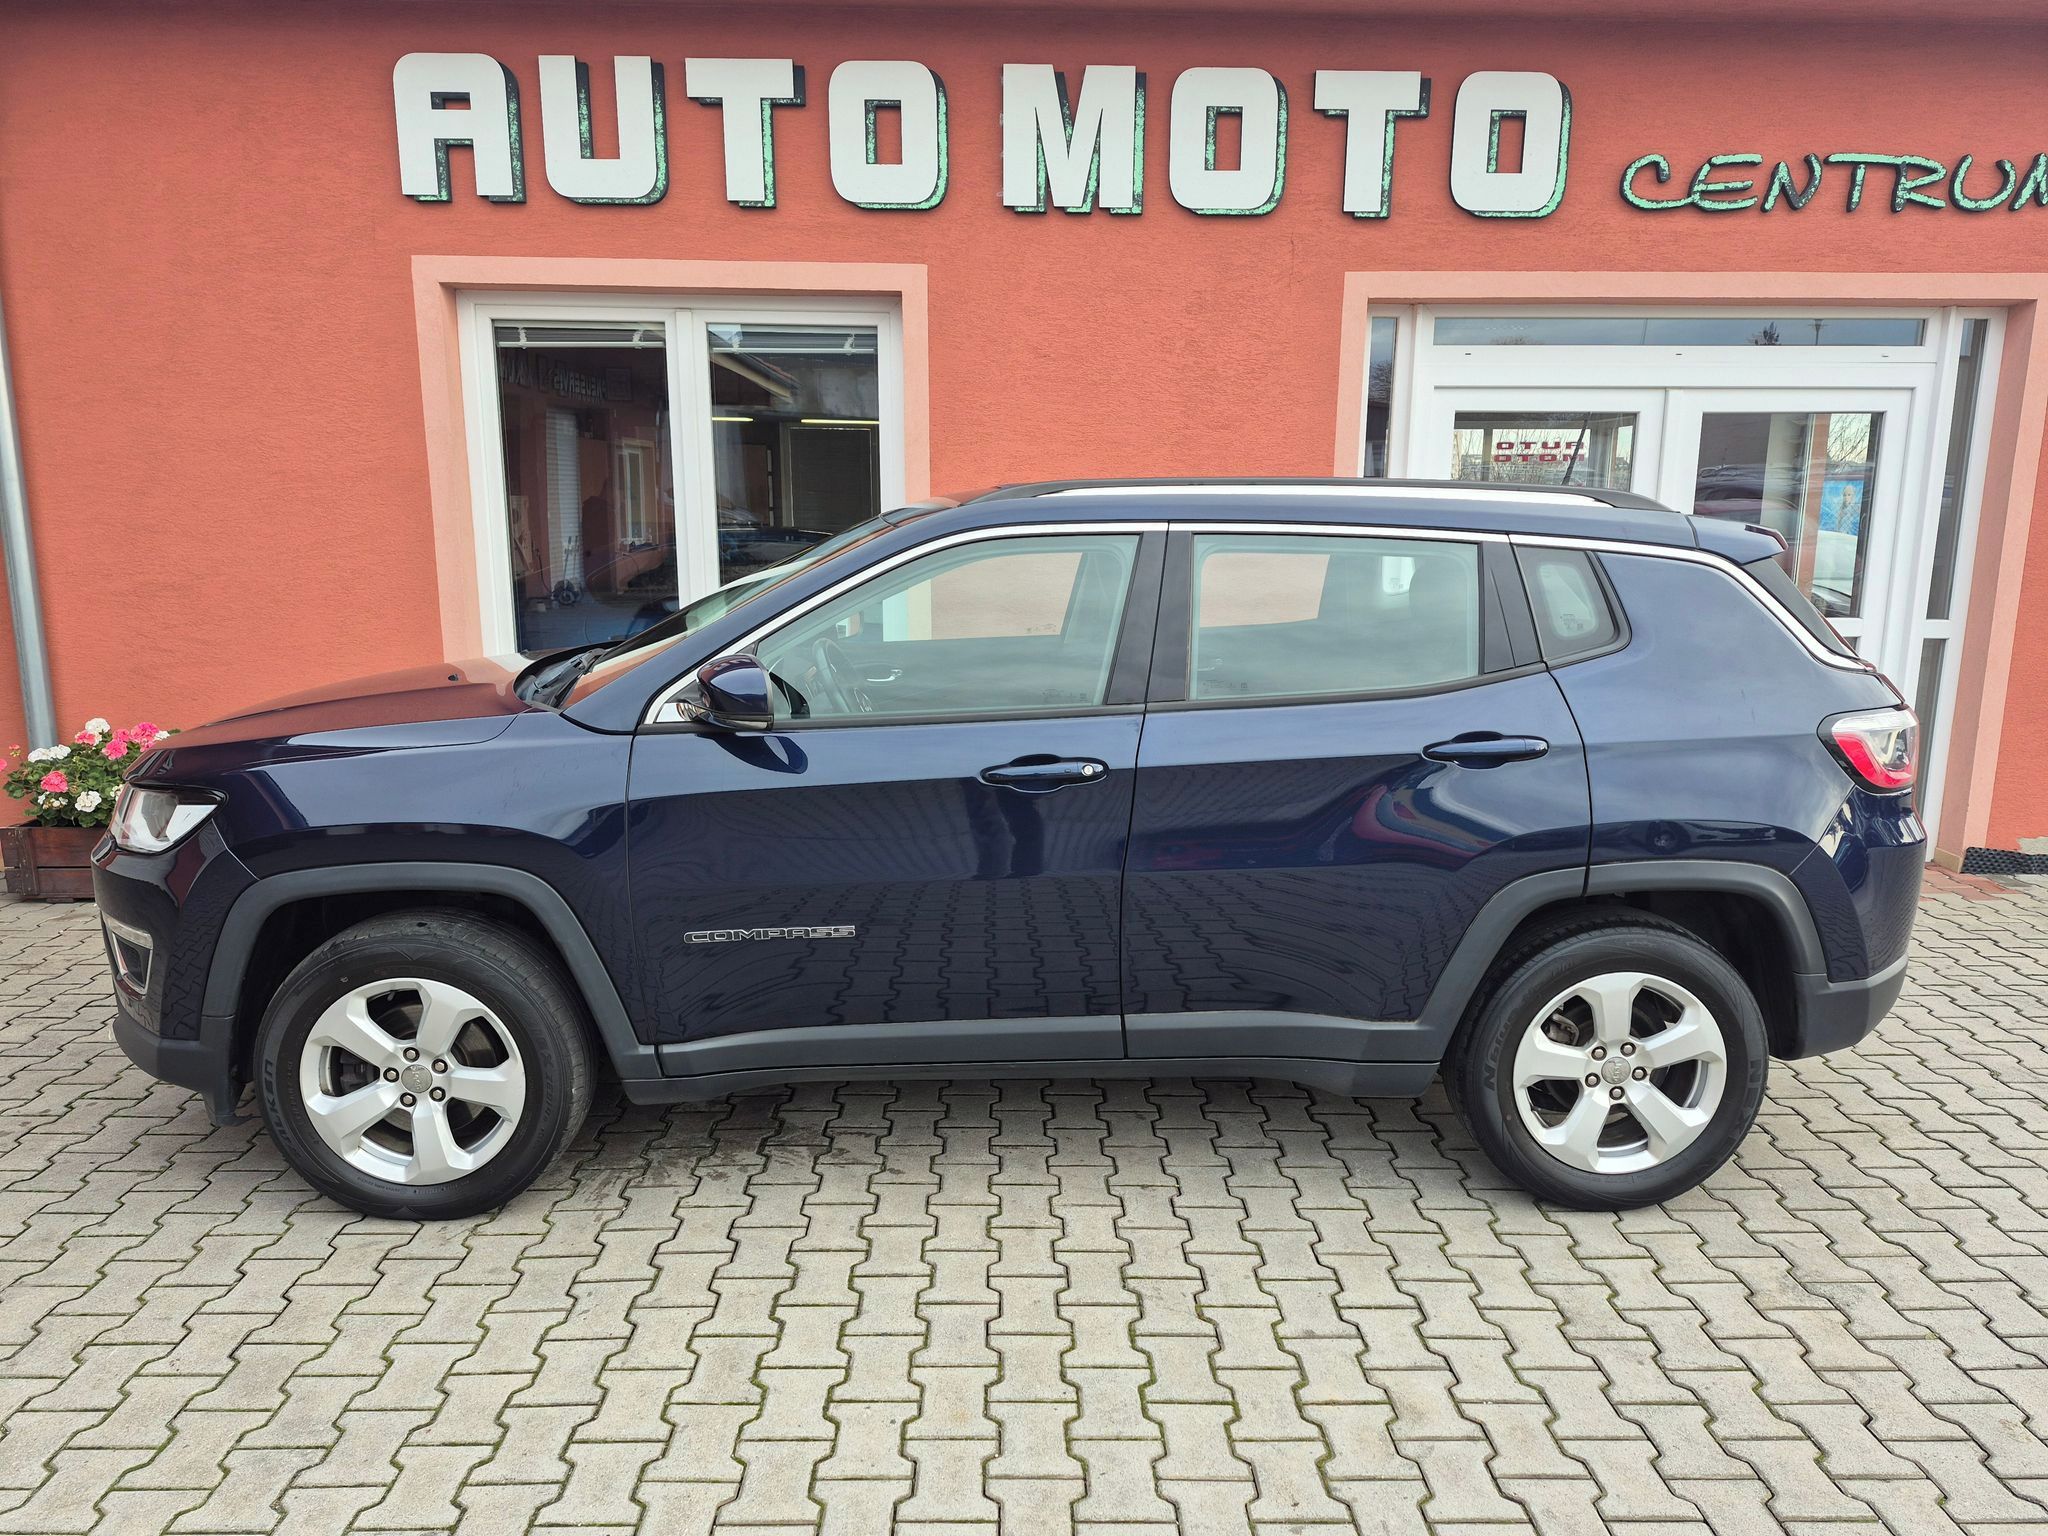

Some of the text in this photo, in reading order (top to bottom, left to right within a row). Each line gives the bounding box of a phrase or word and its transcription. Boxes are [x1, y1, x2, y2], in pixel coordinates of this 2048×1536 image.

[393, 52, 1572, 218] AUTO MOTO
[683, 925, 856, 943] COMPASS
